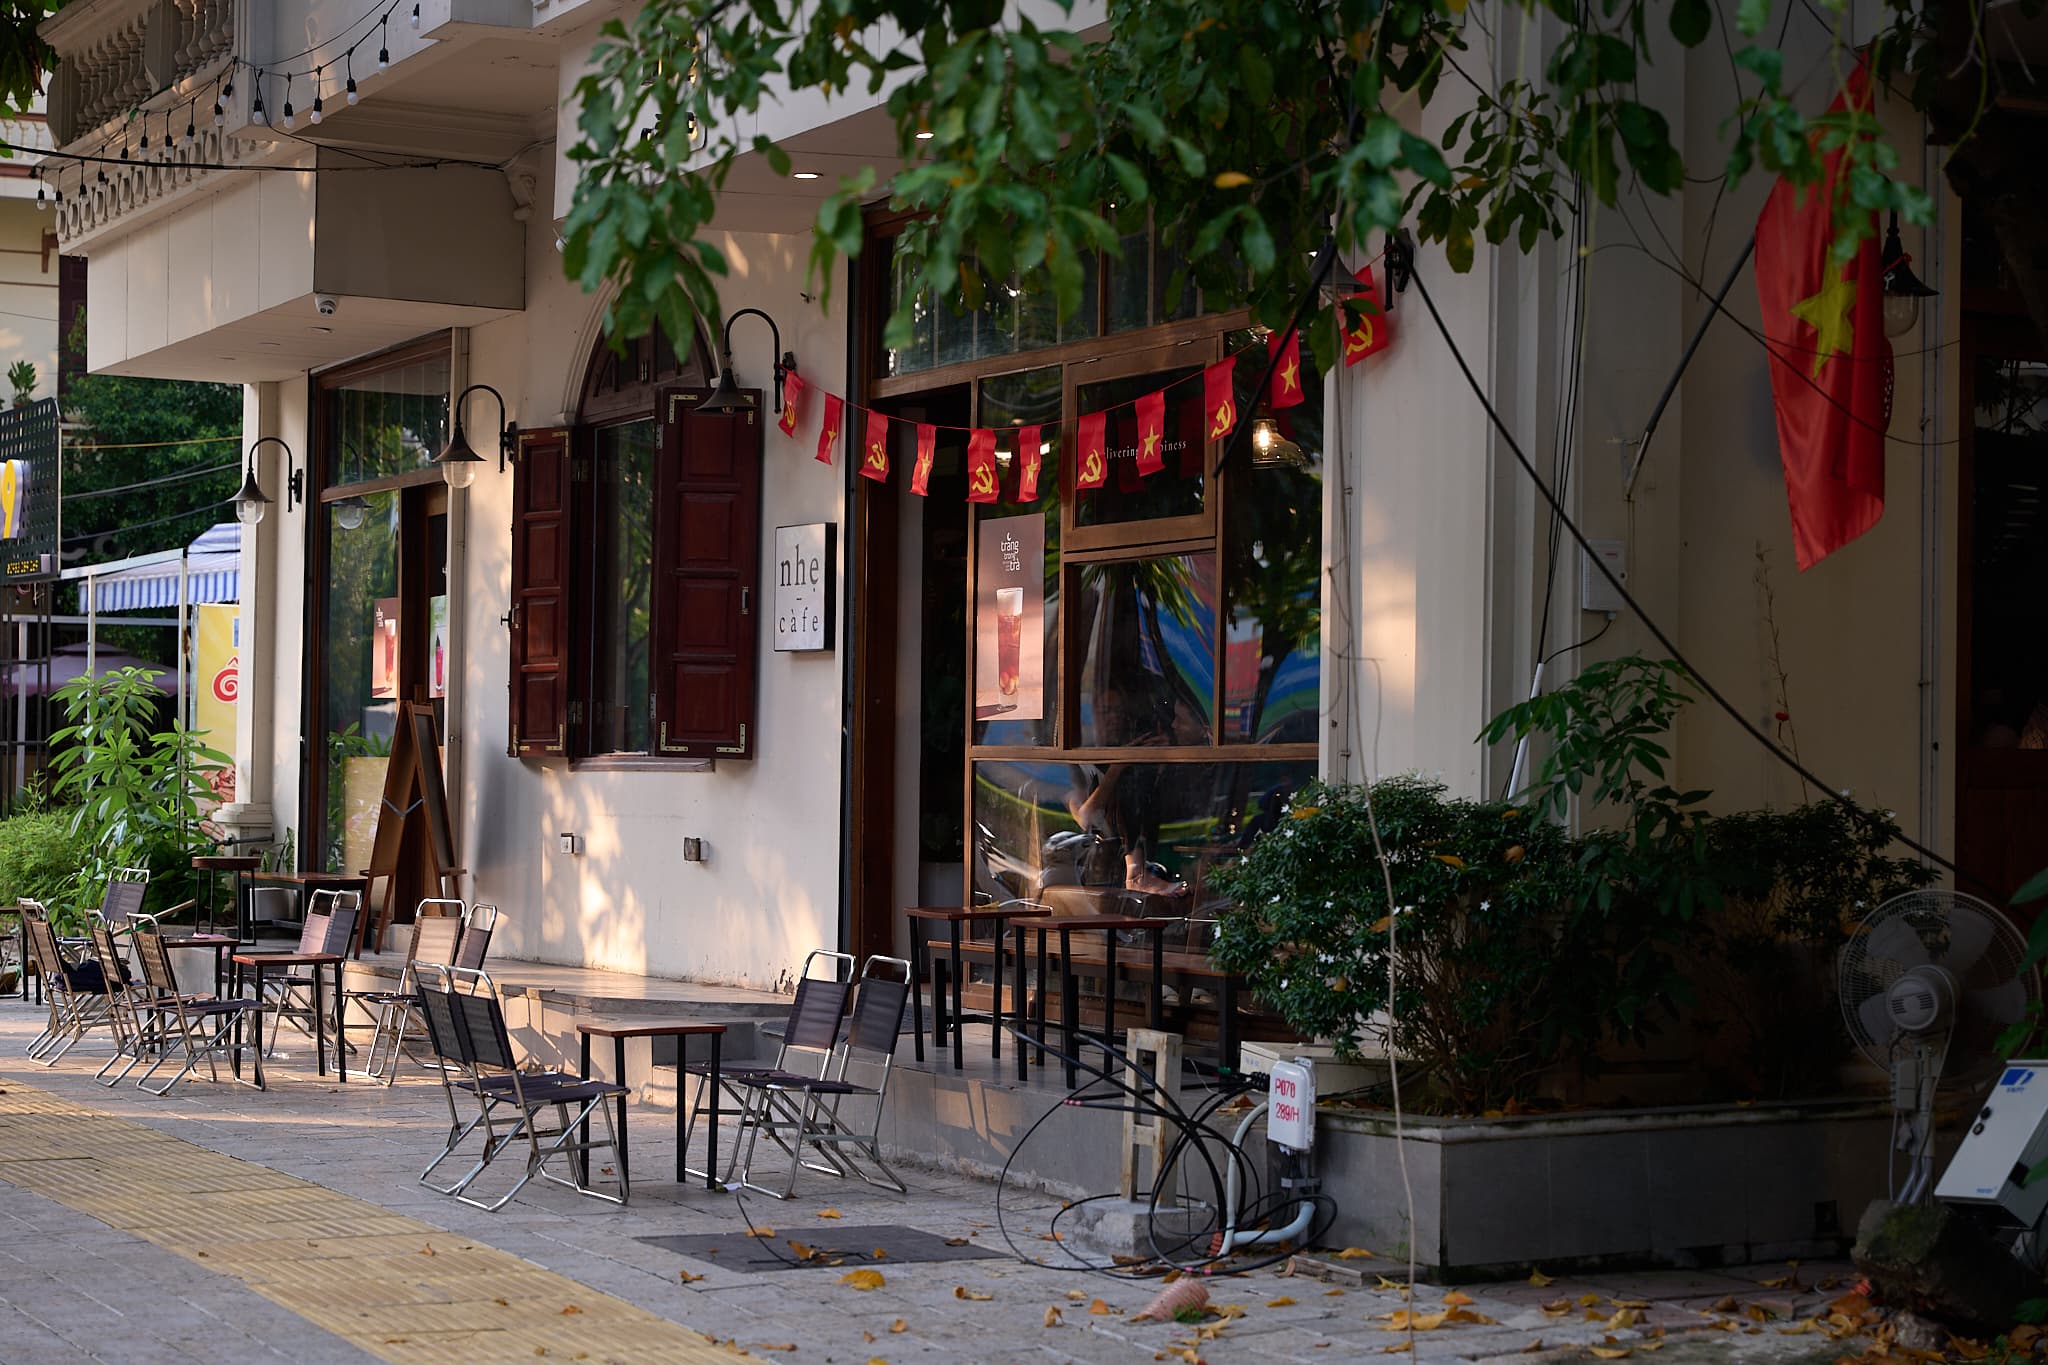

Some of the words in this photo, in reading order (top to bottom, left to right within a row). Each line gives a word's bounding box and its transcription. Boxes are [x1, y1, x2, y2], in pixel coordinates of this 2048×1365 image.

[1104, 445, 1139, 460] liverin
[1160, 440, 1187, 452] iness
[780, 544, 819, 592] nhẹ
